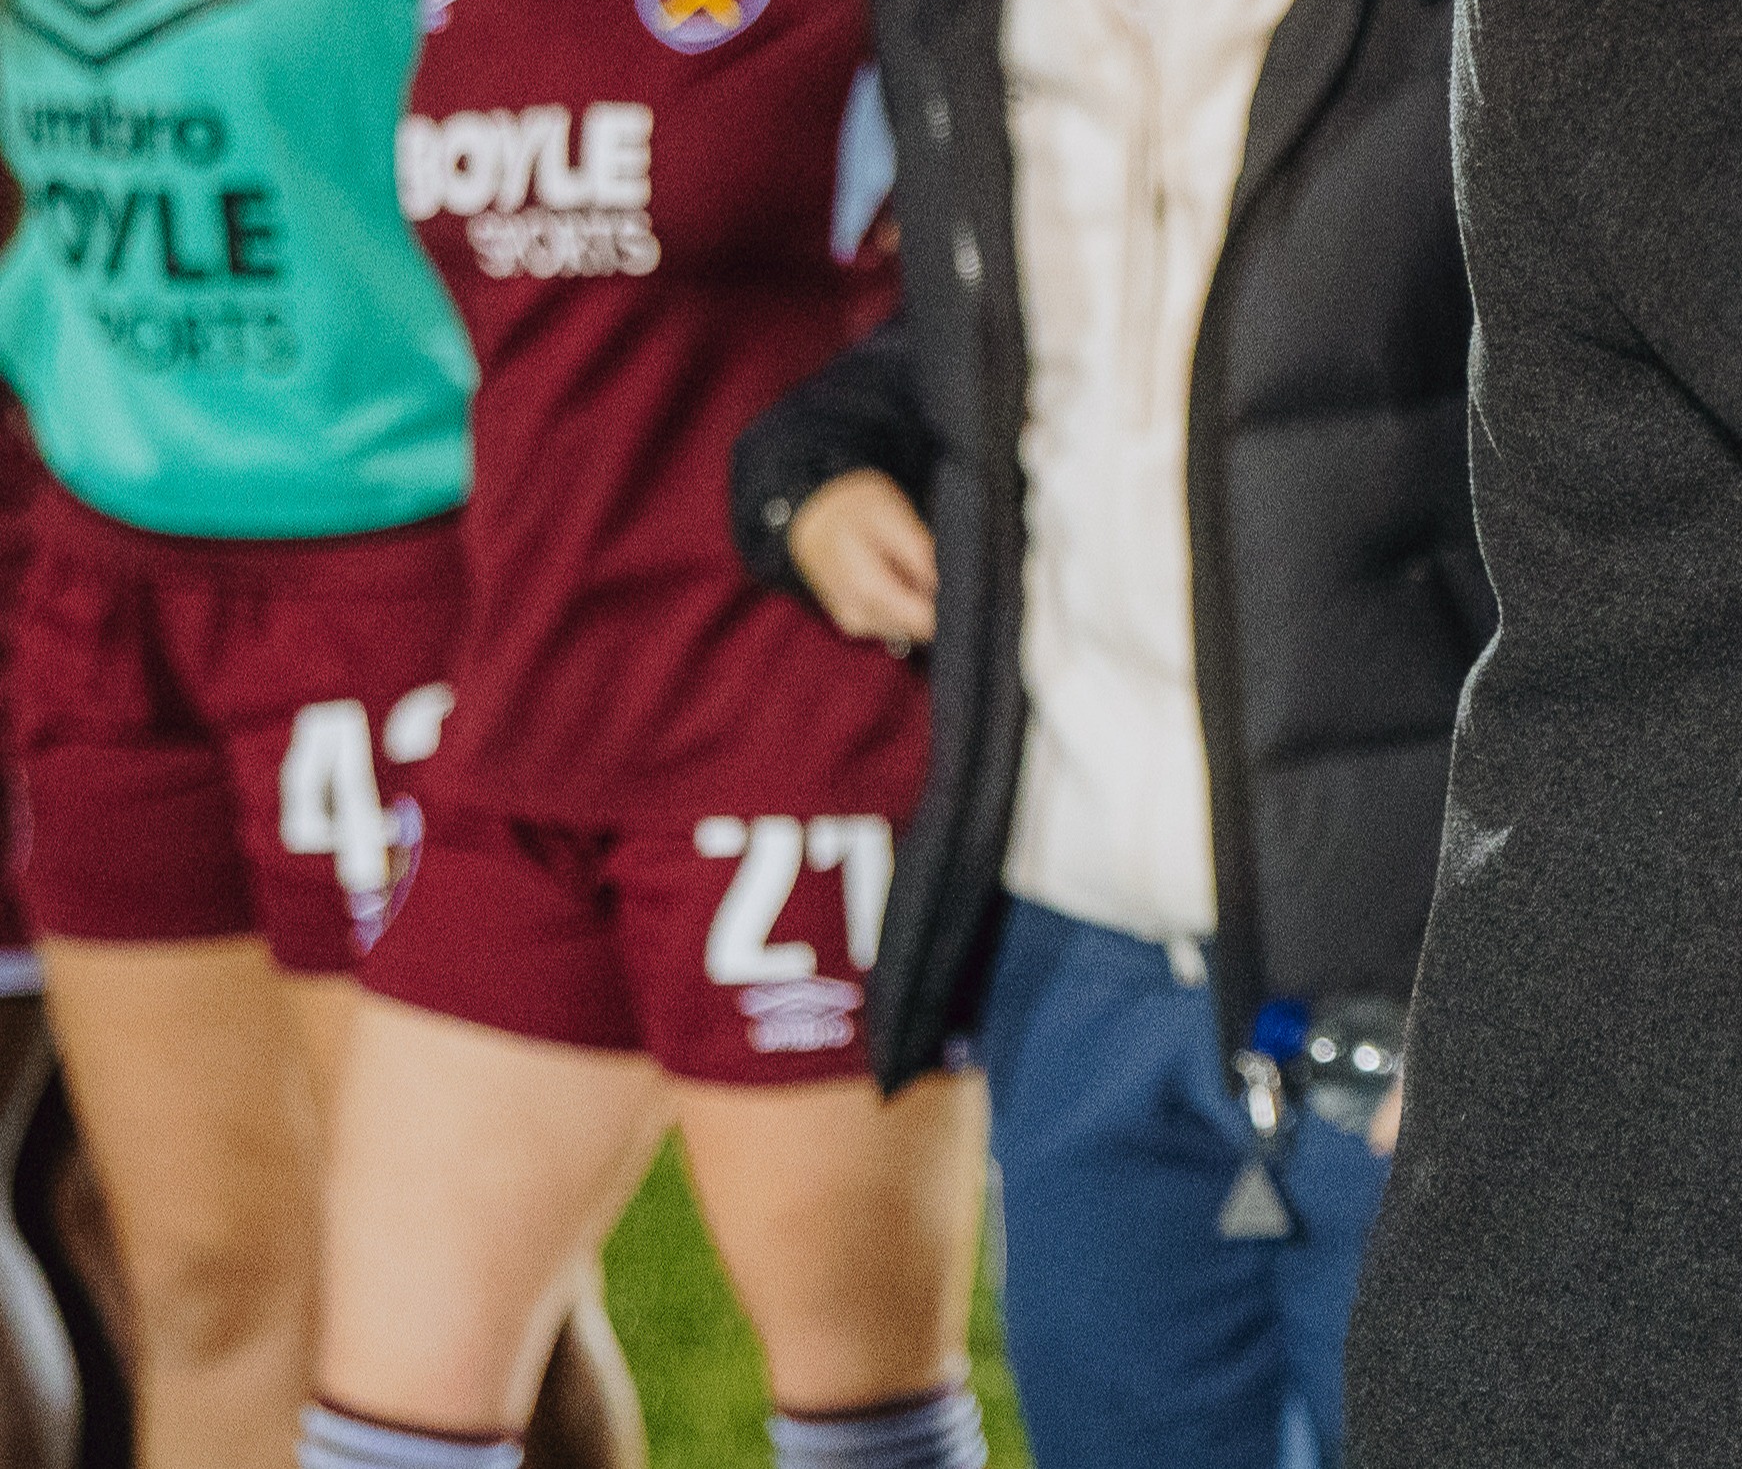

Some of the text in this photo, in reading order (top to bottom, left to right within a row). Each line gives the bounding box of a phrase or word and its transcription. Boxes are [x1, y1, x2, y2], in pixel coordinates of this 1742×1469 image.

[26, 178, 281, 282] OYLE
[466, 210, 661, 278] SPORTS
[279, 683, 454, 894] 4
[693, 813, 894, 985] 27
